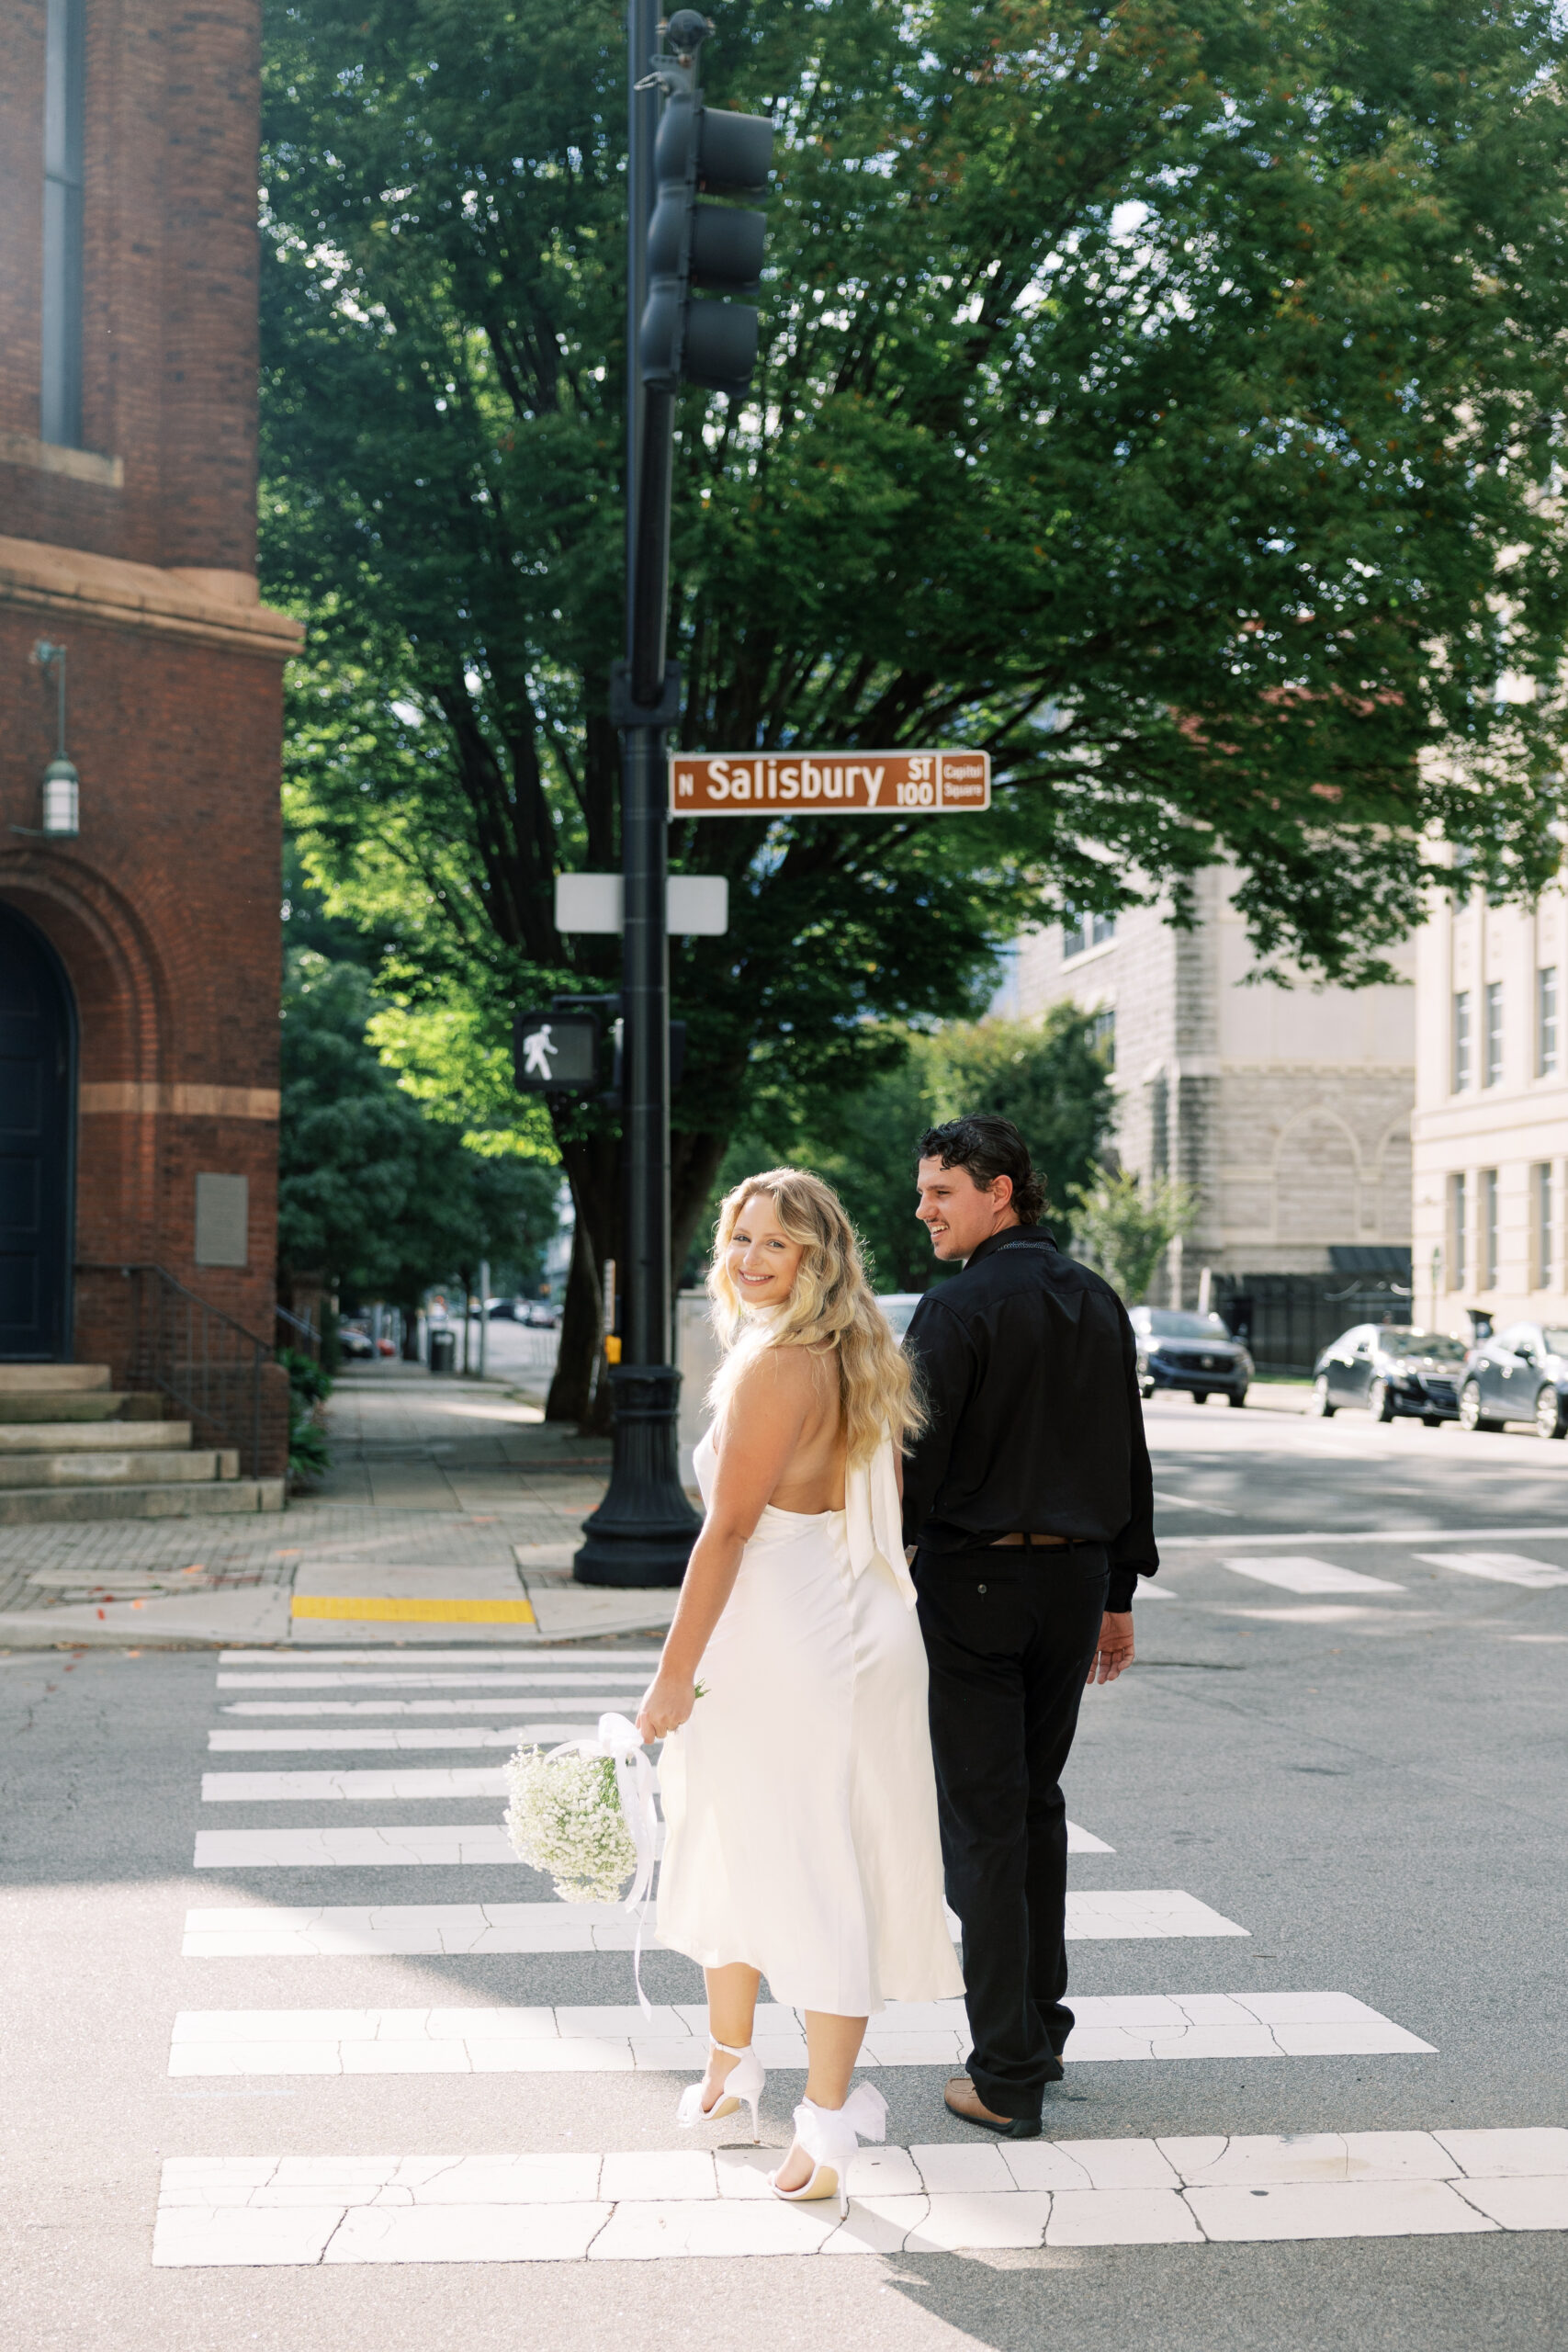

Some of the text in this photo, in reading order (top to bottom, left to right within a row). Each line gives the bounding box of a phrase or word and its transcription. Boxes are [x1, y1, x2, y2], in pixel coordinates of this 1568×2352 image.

[679, 757, 933, 807] N Salisbury ST
[897, 782, 934, 806] 100
[943, 782, 983, 799] Square
